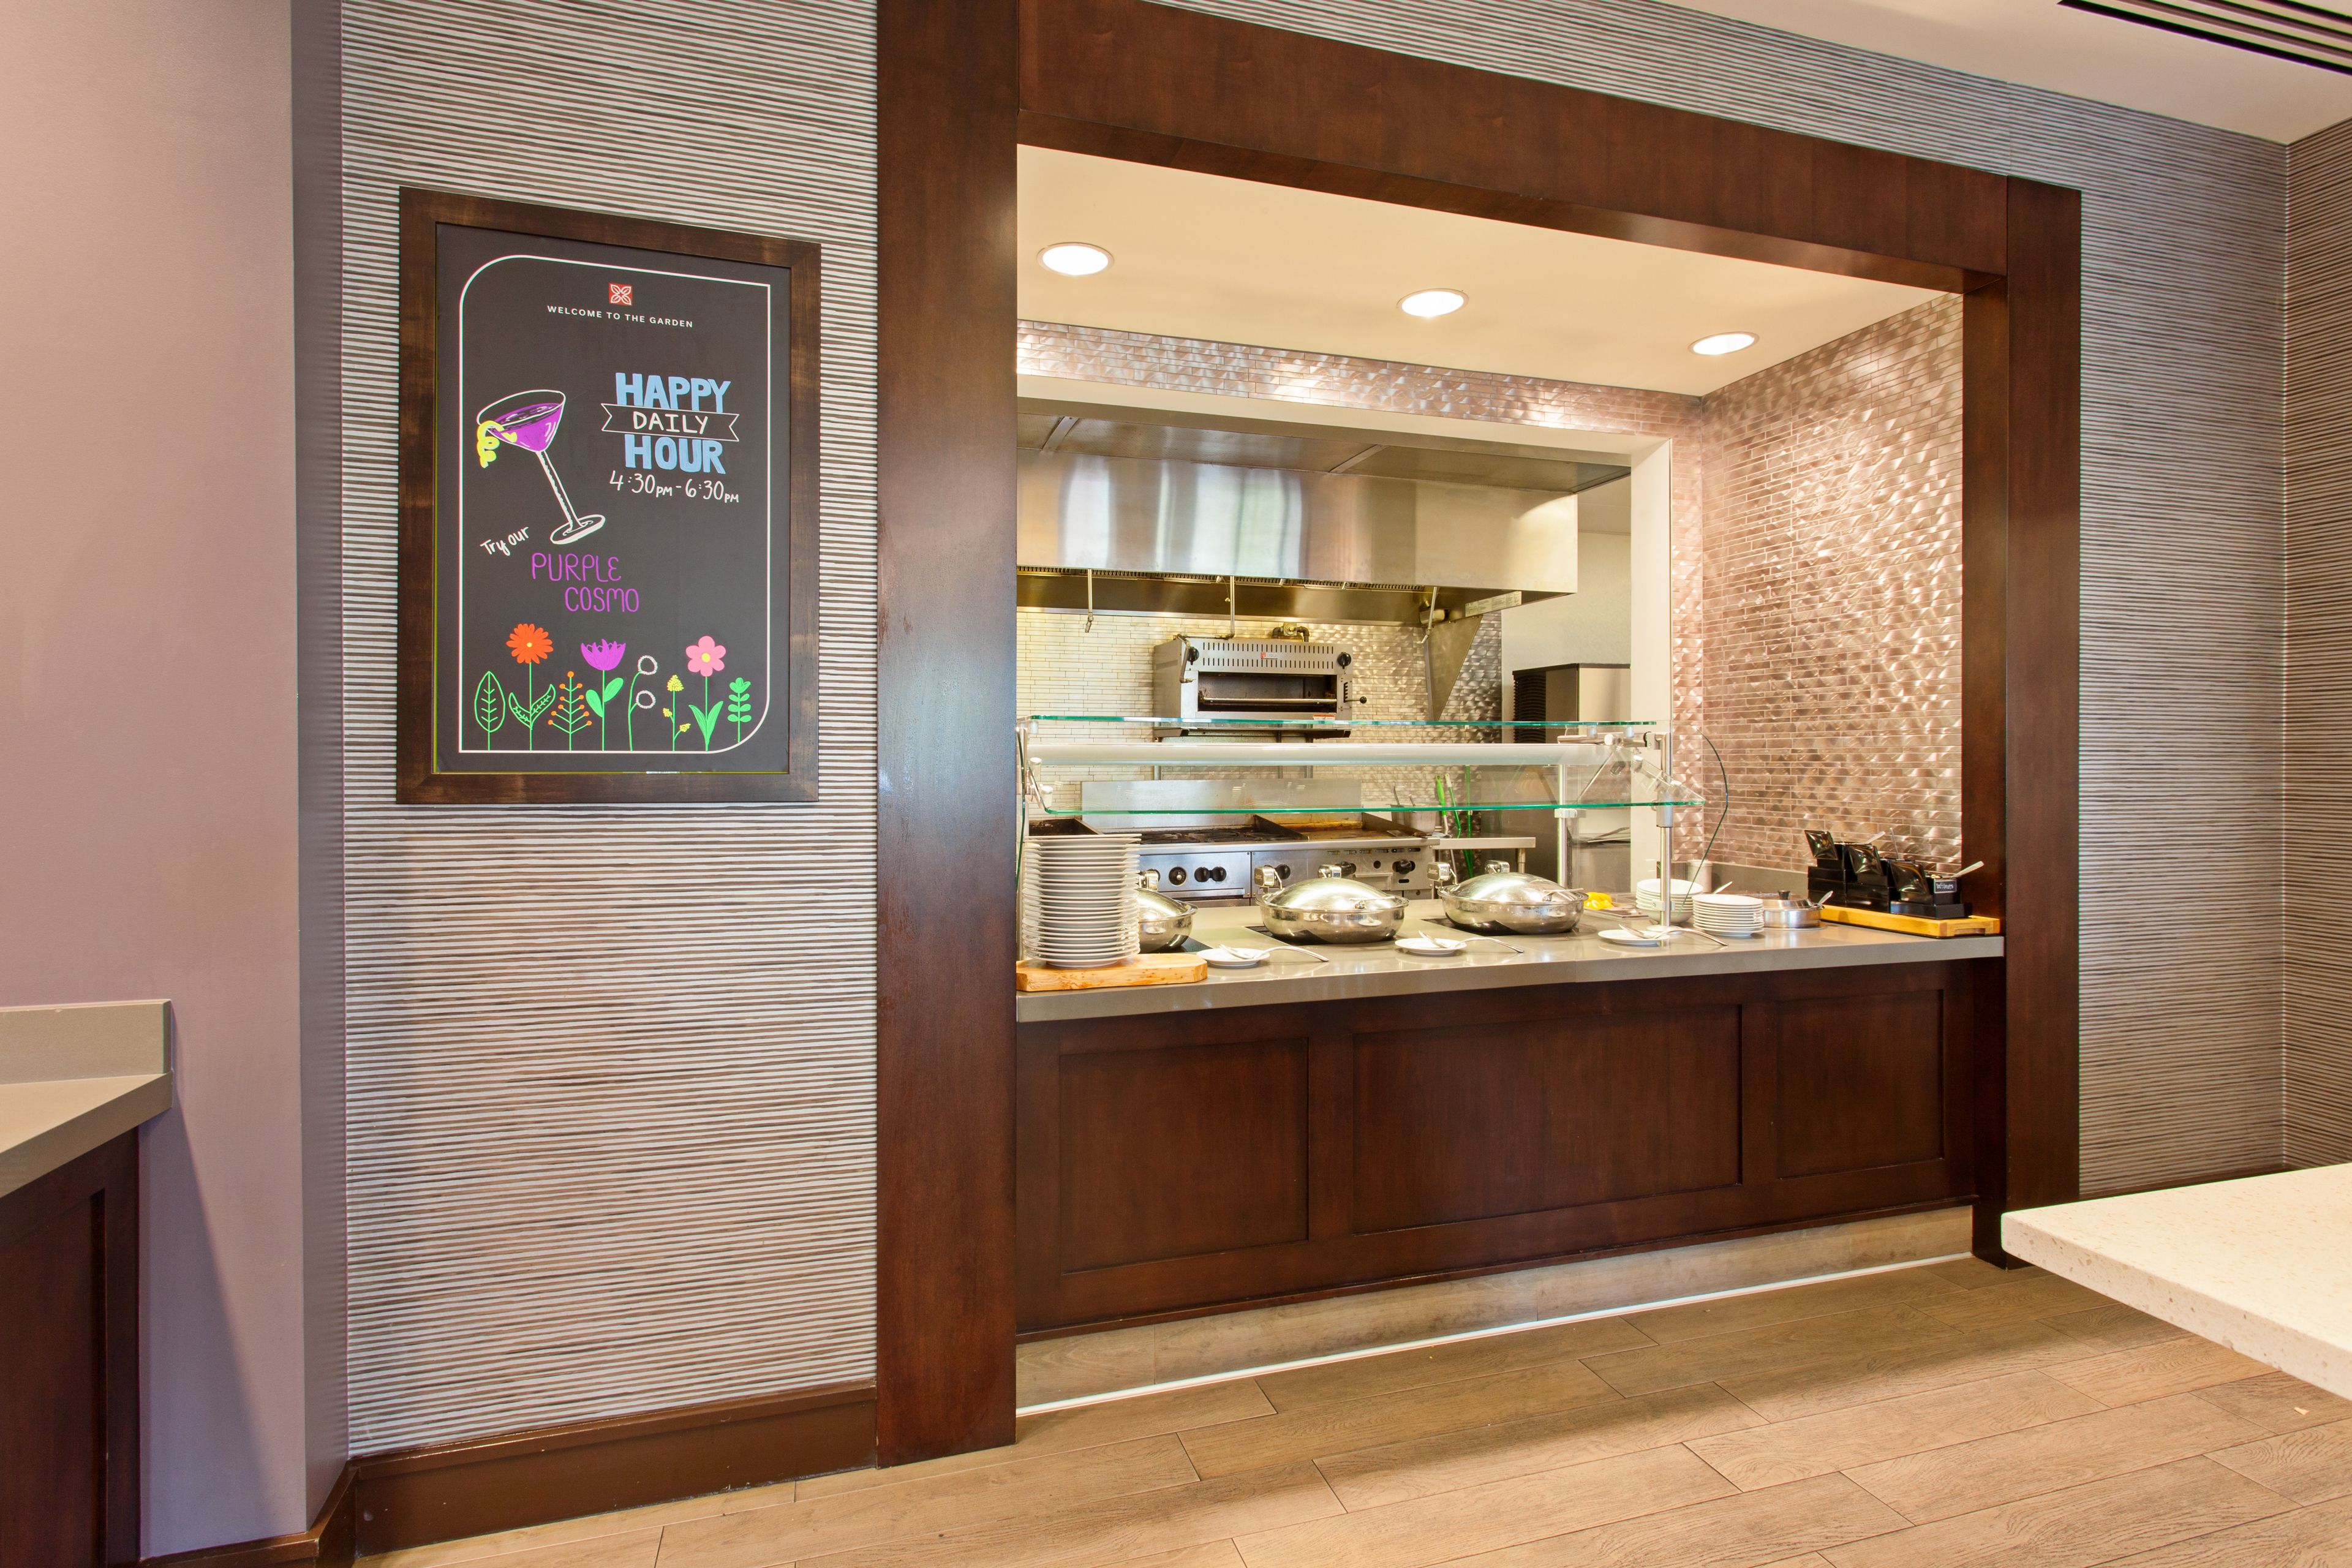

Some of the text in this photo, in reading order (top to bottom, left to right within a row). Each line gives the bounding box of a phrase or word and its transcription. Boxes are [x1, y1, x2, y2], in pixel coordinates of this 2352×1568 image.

[547, 305, 602, 318] WELCOME
[625, 314, 645, 323] THE
[649, 317, 693, 328] GARDEN
[616, 372, 731, 413] HAPPY
[633, 411, 708, 434] DAILY
[624, 434, 726, 474] HOUR
[480, 527, 529, 556] Try our
[532, 552, 622, 582] PURPLE
[565, 587, 639, 612] COSMO
